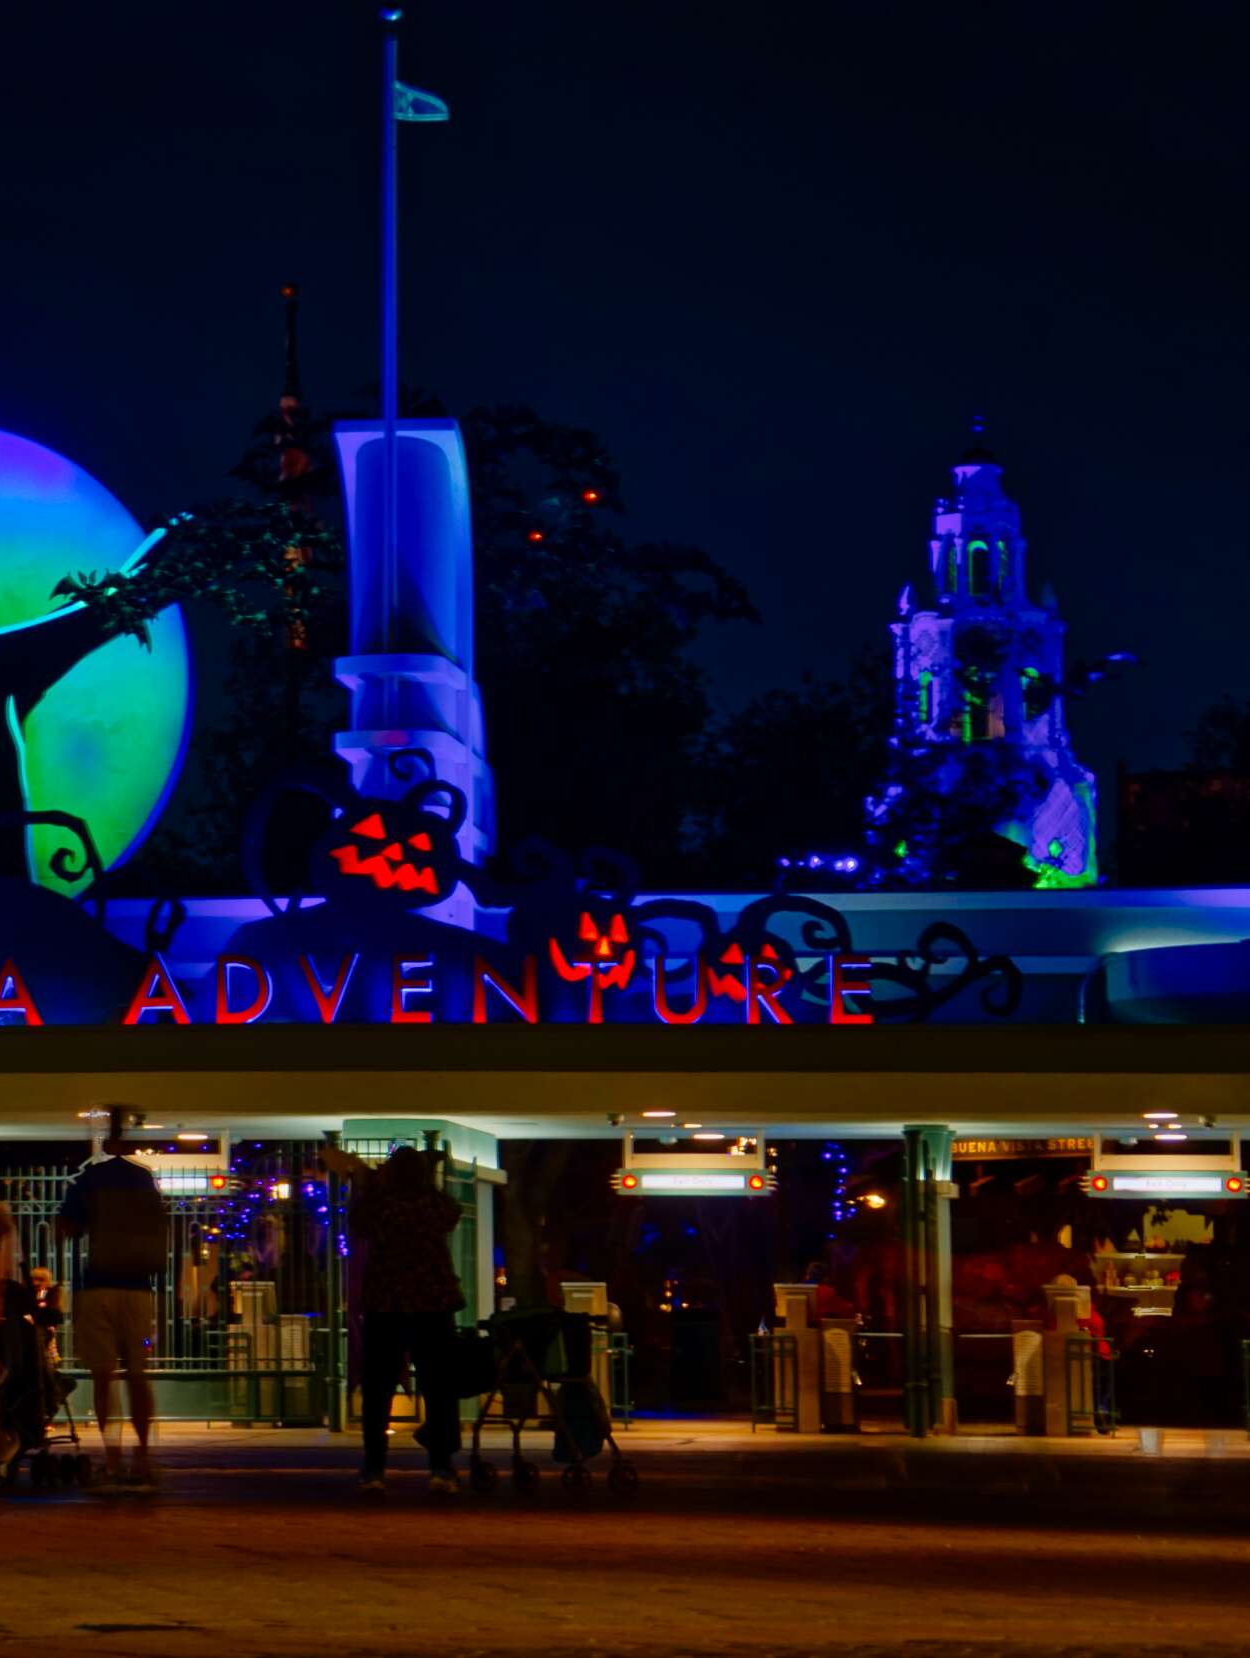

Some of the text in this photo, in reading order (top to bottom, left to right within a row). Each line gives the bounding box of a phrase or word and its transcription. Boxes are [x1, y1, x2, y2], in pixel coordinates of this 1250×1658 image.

[123, 952, 873, 1025] ADVENTURE
[950, 1139, 997, 1153] BUENA
[1047, 1137, 1094, 1150] STREE
